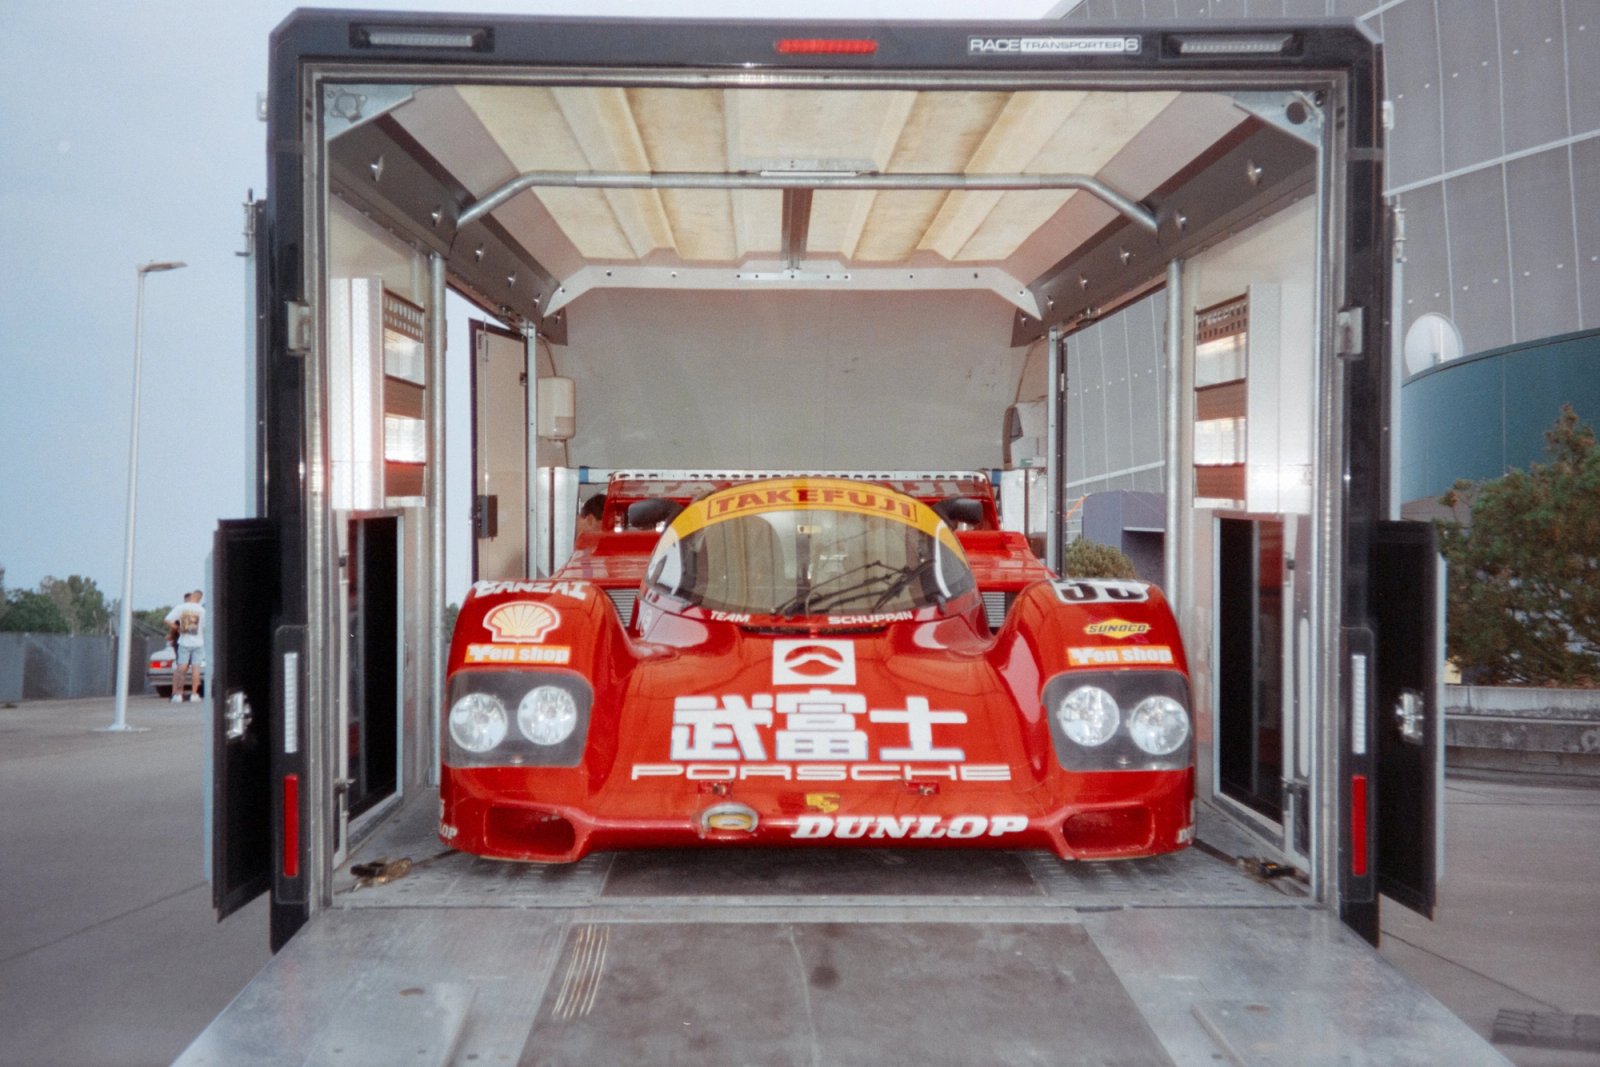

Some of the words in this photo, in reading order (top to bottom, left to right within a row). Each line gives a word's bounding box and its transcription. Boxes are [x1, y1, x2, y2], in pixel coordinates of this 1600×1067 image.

[970, 38, 1020, 51] RACE
[1023, 40, 1122, 50] TRANSPORTER
[715, 488, 912, 518] TAKEFUJI
[710, 610, 750, 622] TEAM
[828, 611, 914, 624] SCHUPPAN
[1088, 624, 1147, 633] SUNOCO
[469, 643, 515, 662] Yen
[519, 646, 569, 664] shop
[1071, 648, 1119, 664] Yen
[1121, 647, 1173, 663] shop
[670, 689, 968, 760] 武富士
[631, 763, 1012, 781] PORSCHE
[790, 815, 1030, 839] DUNLOP
